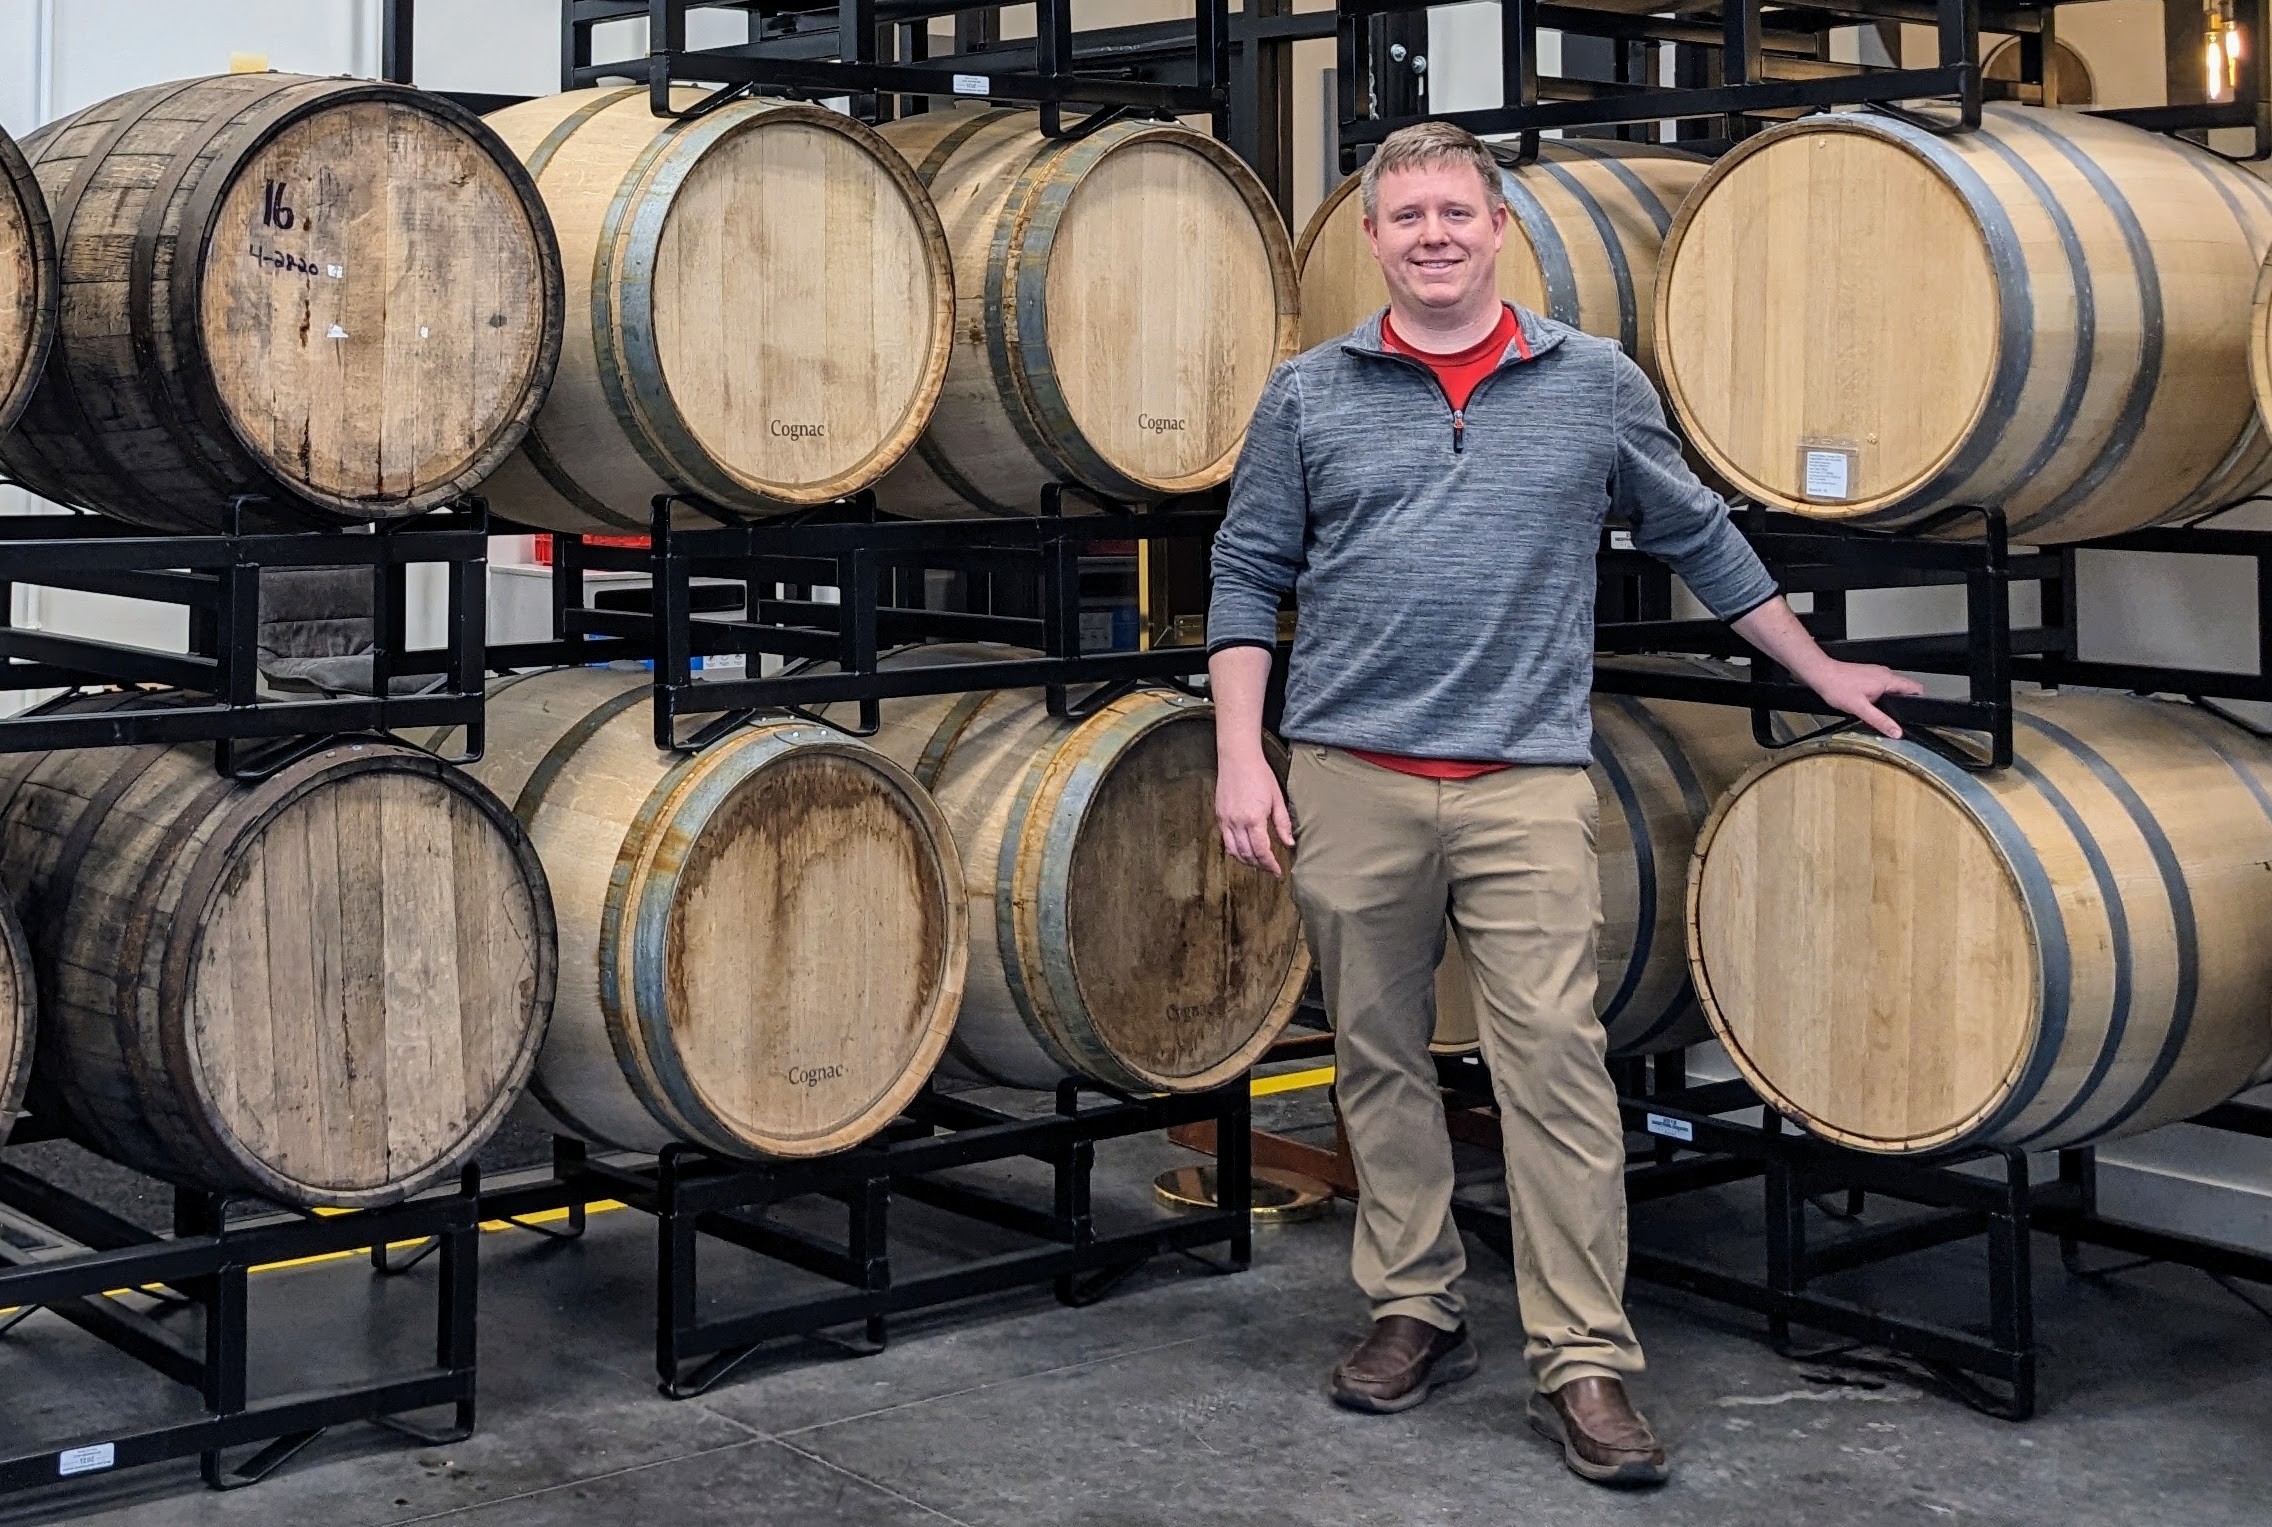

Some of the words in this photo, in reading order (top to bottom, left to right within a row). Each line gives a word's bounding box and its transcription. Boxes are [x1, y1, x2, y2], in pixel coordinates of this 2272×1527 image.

[263, 178, 295, 230] 16
[770, 419, 825, 442] Cognac
[1138, 413, 1186, 435] Cognac
[788, 1064, 844, 1088] Cognac
